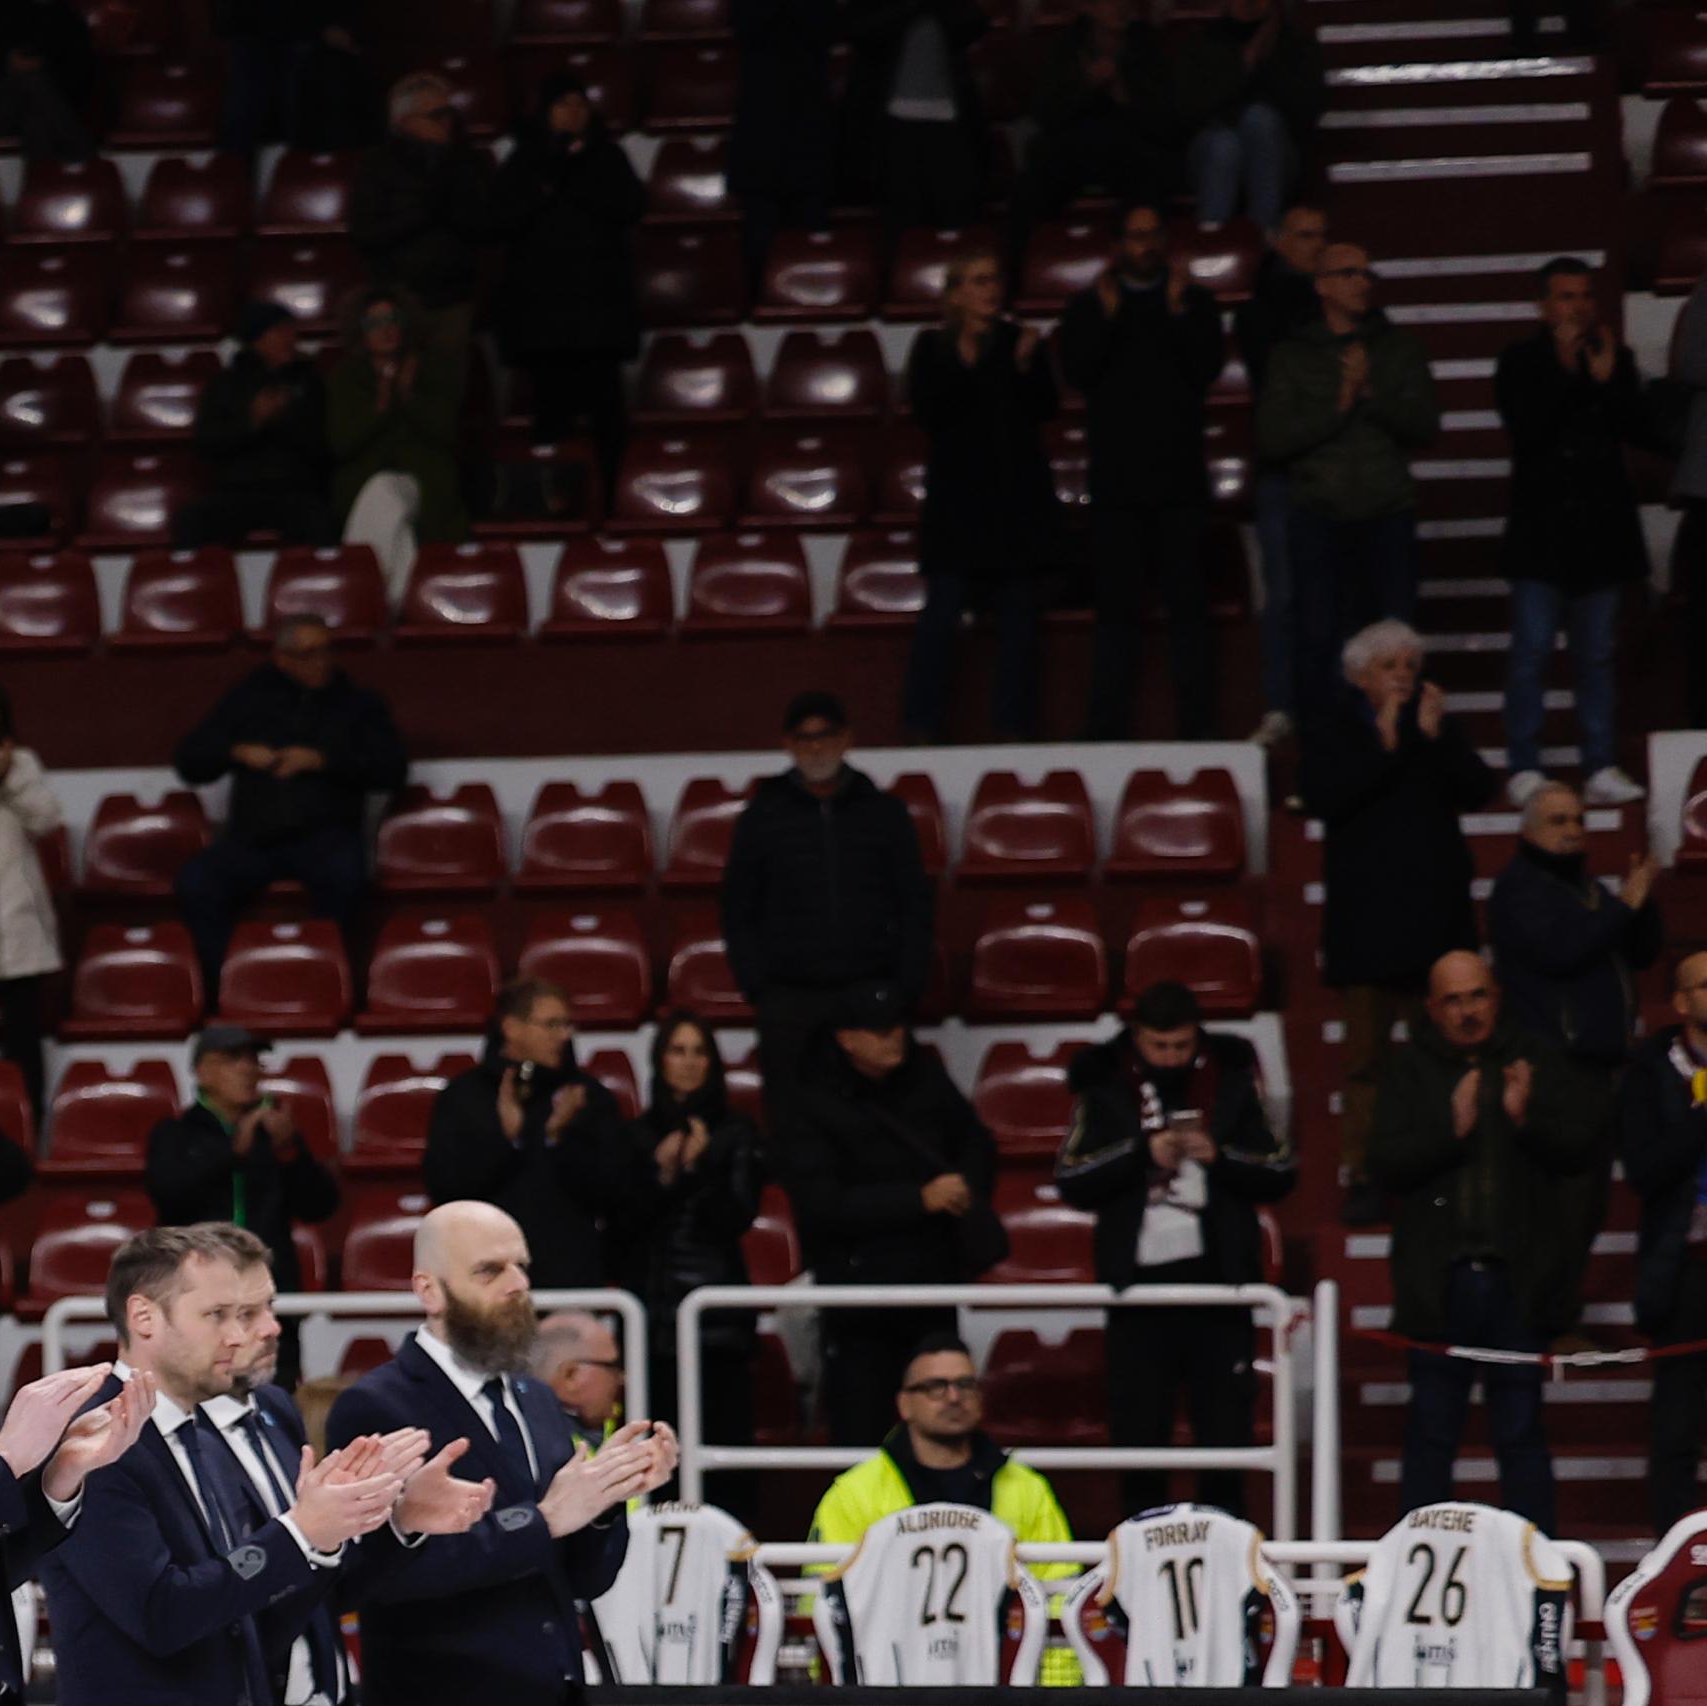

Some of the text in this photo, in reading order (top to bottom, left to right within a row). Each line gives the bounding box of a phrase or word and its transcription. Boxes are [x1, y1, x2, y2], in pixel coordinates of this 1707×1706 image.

[896, 1510, 982, 1535] ALDRIDGE
[1144, 1521, 1211, 1552] FORRAY
[659, 1526, 687, 1605] 7
[910, 1542, 968, 1627] 22
[1406, 1543, 1467, 1627] 26
